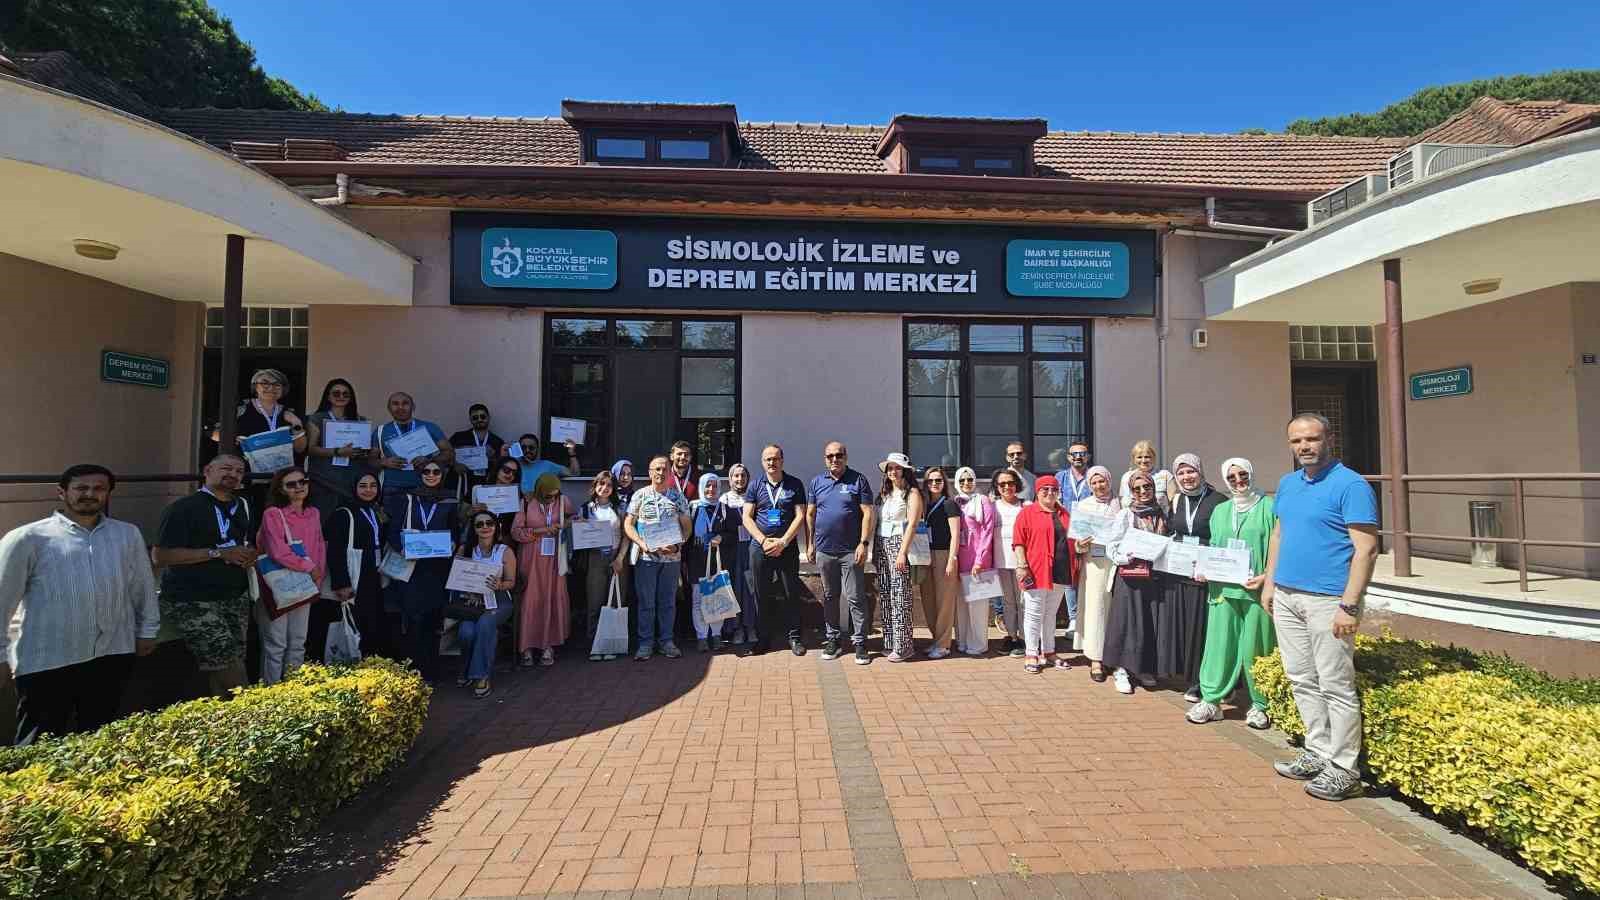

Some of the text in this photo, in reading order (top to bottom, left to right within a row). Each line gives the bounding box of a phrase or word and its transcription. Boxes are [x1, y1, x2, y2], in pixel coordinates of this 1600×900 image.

[667, 235, 960, 265] SİSMOLOJİK İZLEME ve
[1049, 249, 1060, 257] VE
[648, 266, 977, 293] DEPREM EĞİTİM MERKEZİ
